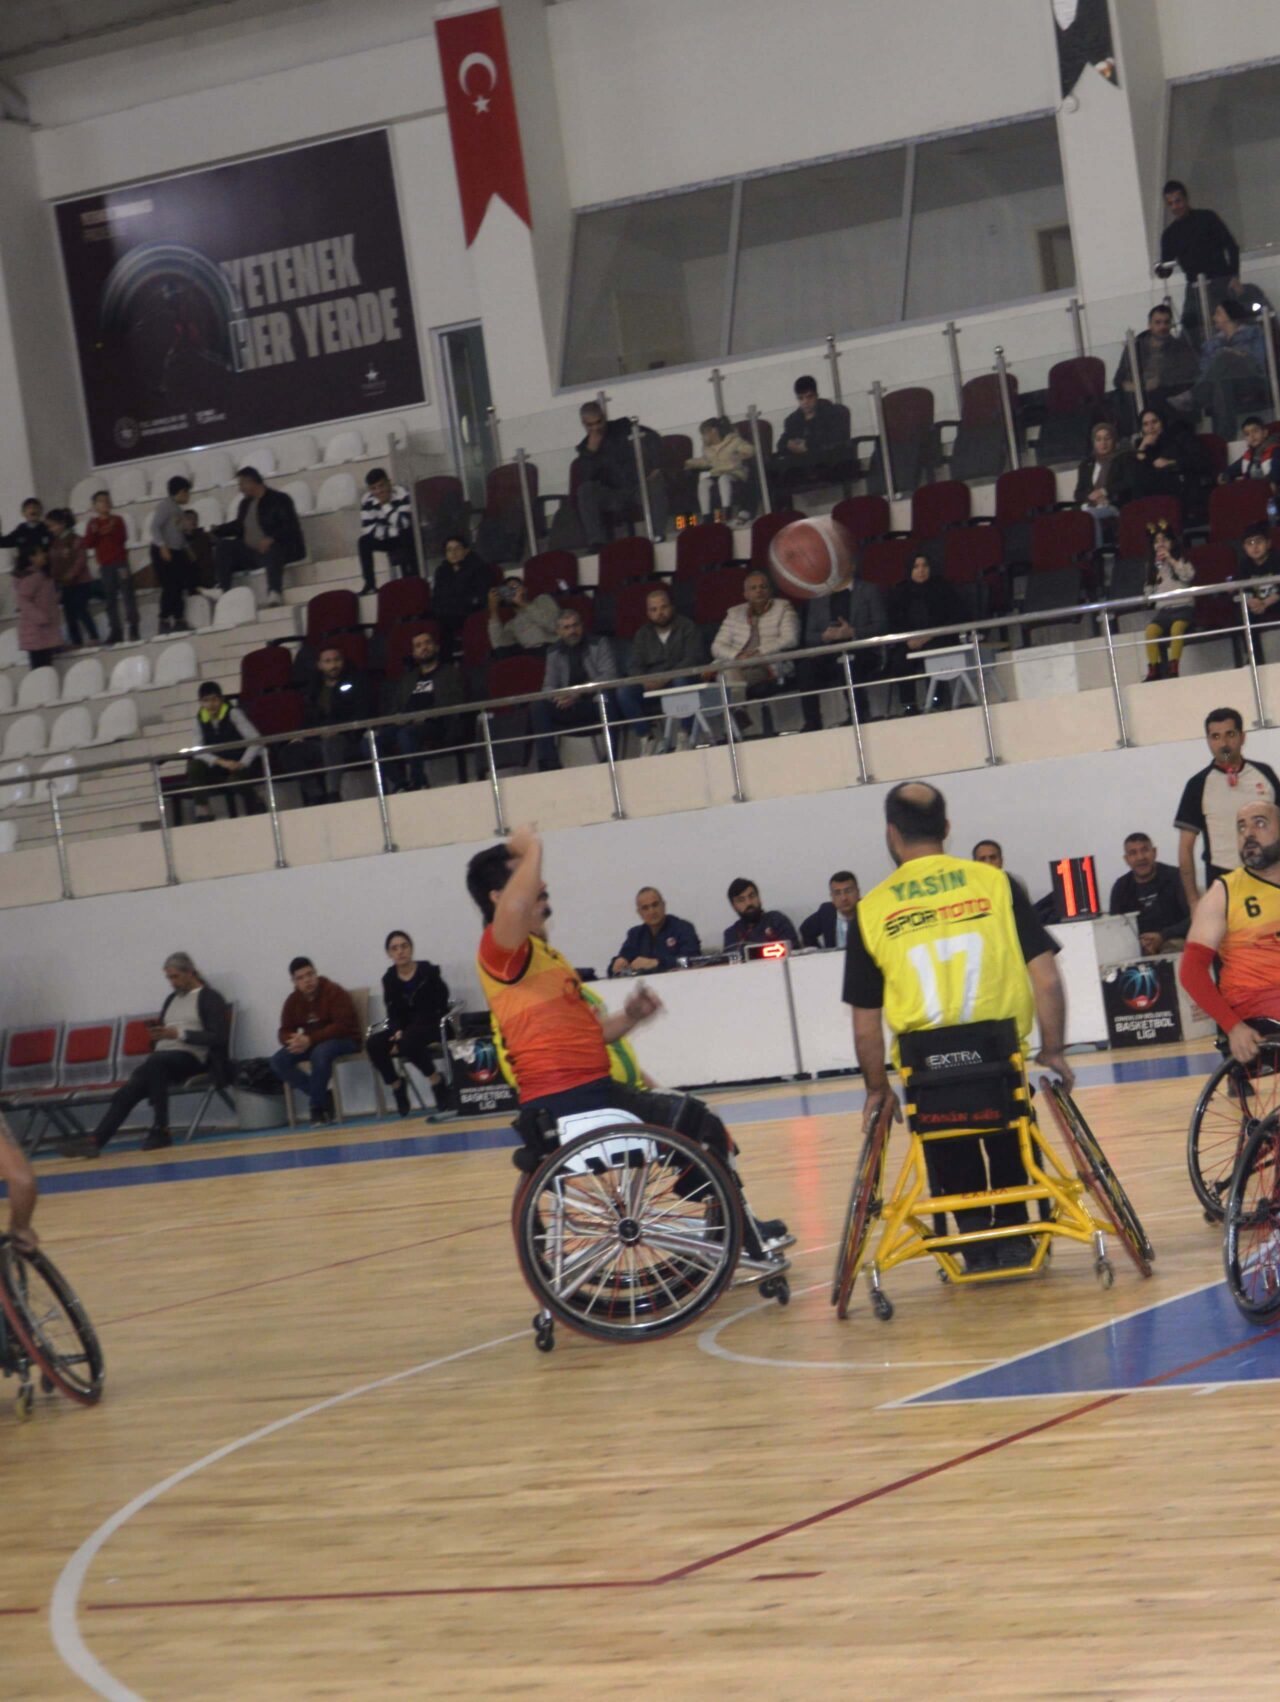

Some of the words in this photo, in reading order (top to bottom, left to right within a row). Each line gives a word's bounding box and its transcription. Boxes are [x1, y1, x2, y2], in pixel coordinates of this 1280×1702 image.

[218, 233, 362, 311] YETENEK
[296, 286, 402, 358] YERDE
[1244, 895, 1261, 918] 6
[905, 931, 985, 1026] 17
[1115, 1017, 1176, 1033] BASKETBOL
[928, 1050, 982, 1067] EXTRA
